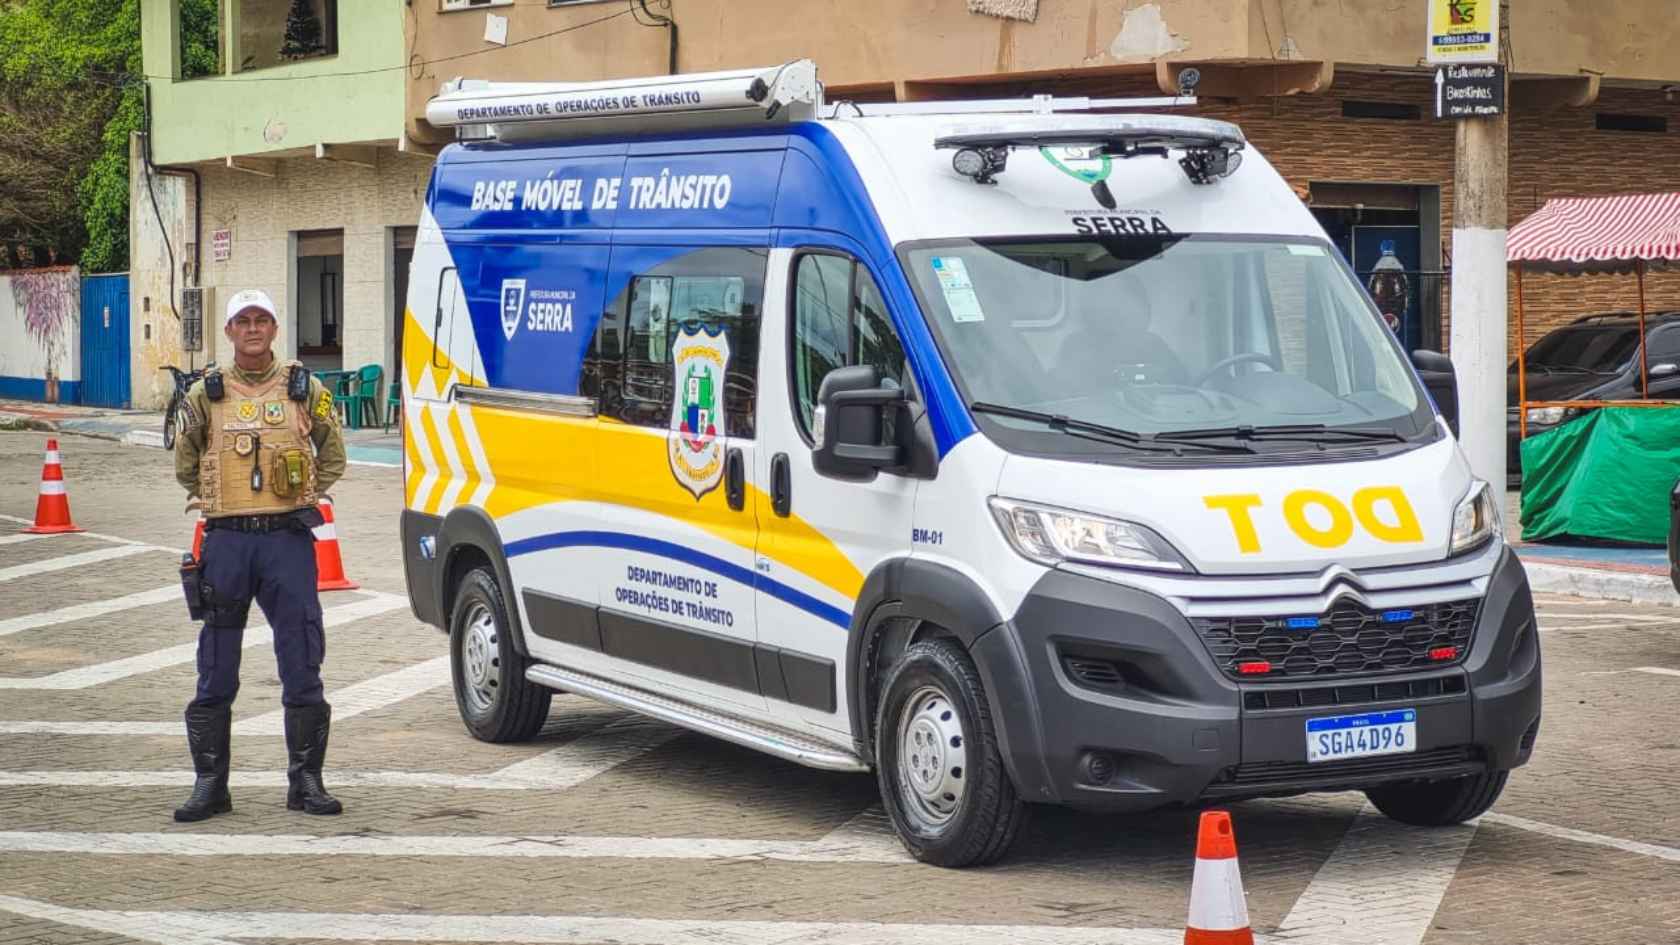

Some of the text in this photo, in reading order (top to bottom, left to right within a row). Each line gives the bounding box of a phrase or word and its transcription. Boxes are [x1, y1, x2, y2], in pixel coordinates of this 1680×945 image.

[457, 103, 534, 120] DEPARTAMENTO
[536, 102, 550, 115] DE
[622, 96, 638, 109] DE
[471, 167, 732, 211] BASE MÓVEL DE TRÂNSITO
[1071, 216, 1172, 234] SERRA
[527, 302, 573, 332] SERRA
[912, 528, 943, 545] BM-01
[627, 565, 718, 599] DEPARTAMENTO DE
[615, 587, 734, 627] OPERAÇÕES DE TRÂNSITO
[1318, 726, 1405, 756] SGA4D96
